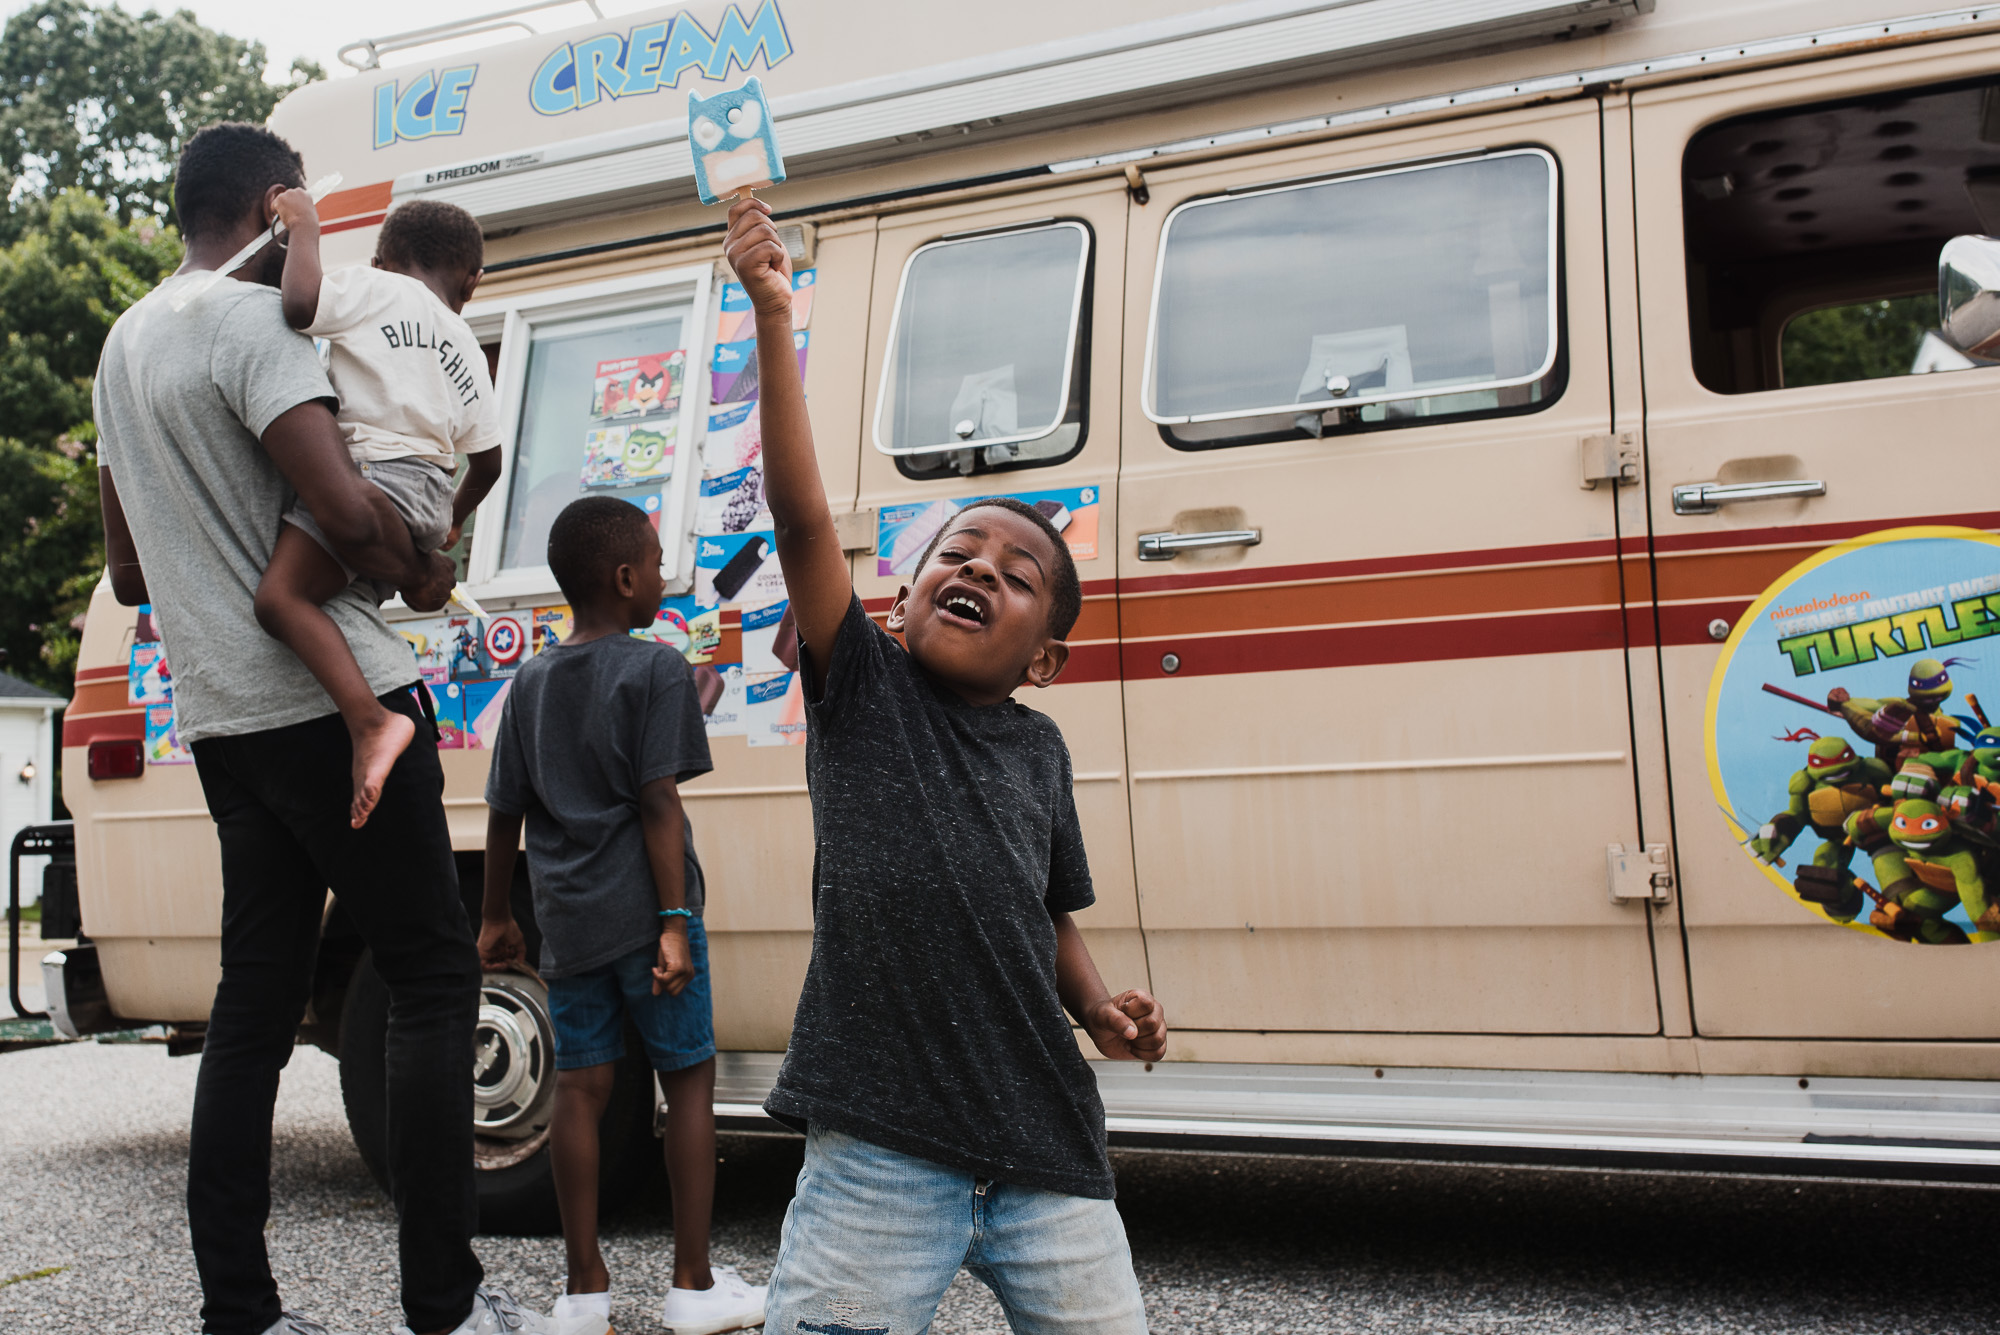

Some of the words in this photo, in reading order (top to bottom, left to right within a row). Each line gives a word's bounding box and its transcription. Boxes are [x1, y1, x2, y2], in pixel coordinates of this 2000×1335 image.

[373, 63, 480, 150] ICE
[528, 0, 794, 116] CREAM
[437, 160, 501, 182] FREEDOM
[765, 580, 785, 588] CREA
[1769, 590, 1871, 621] nickelodeon
[1774, 605, 1858, 637] TEENAGE
[1862, 585, 1946, 619] MUTANT
[1947, 573, 2000, 600] NINJ
